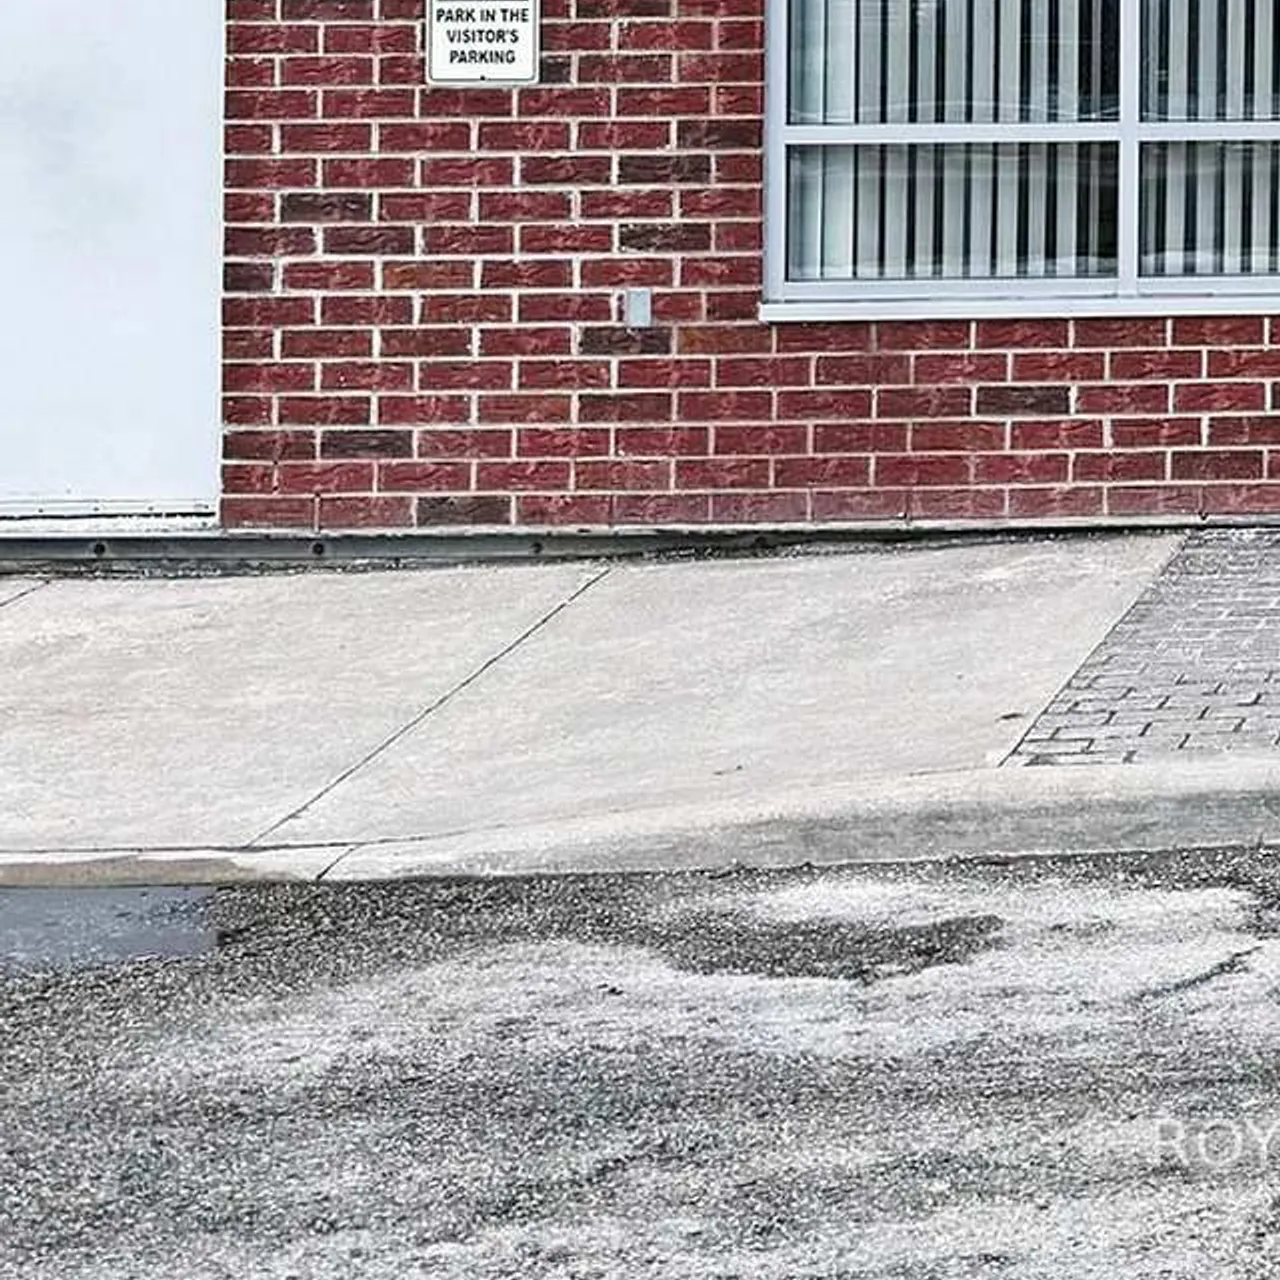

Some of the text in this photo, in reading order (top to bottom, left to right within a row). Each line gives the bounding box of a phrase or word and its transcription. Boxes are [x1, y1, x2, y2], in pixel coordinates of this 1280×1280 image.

[436, 8, 529, 22] PARK IN THE
[446, 29, 519, 43] VISITOR'S
[450, 50, 515, 64] PARKING
